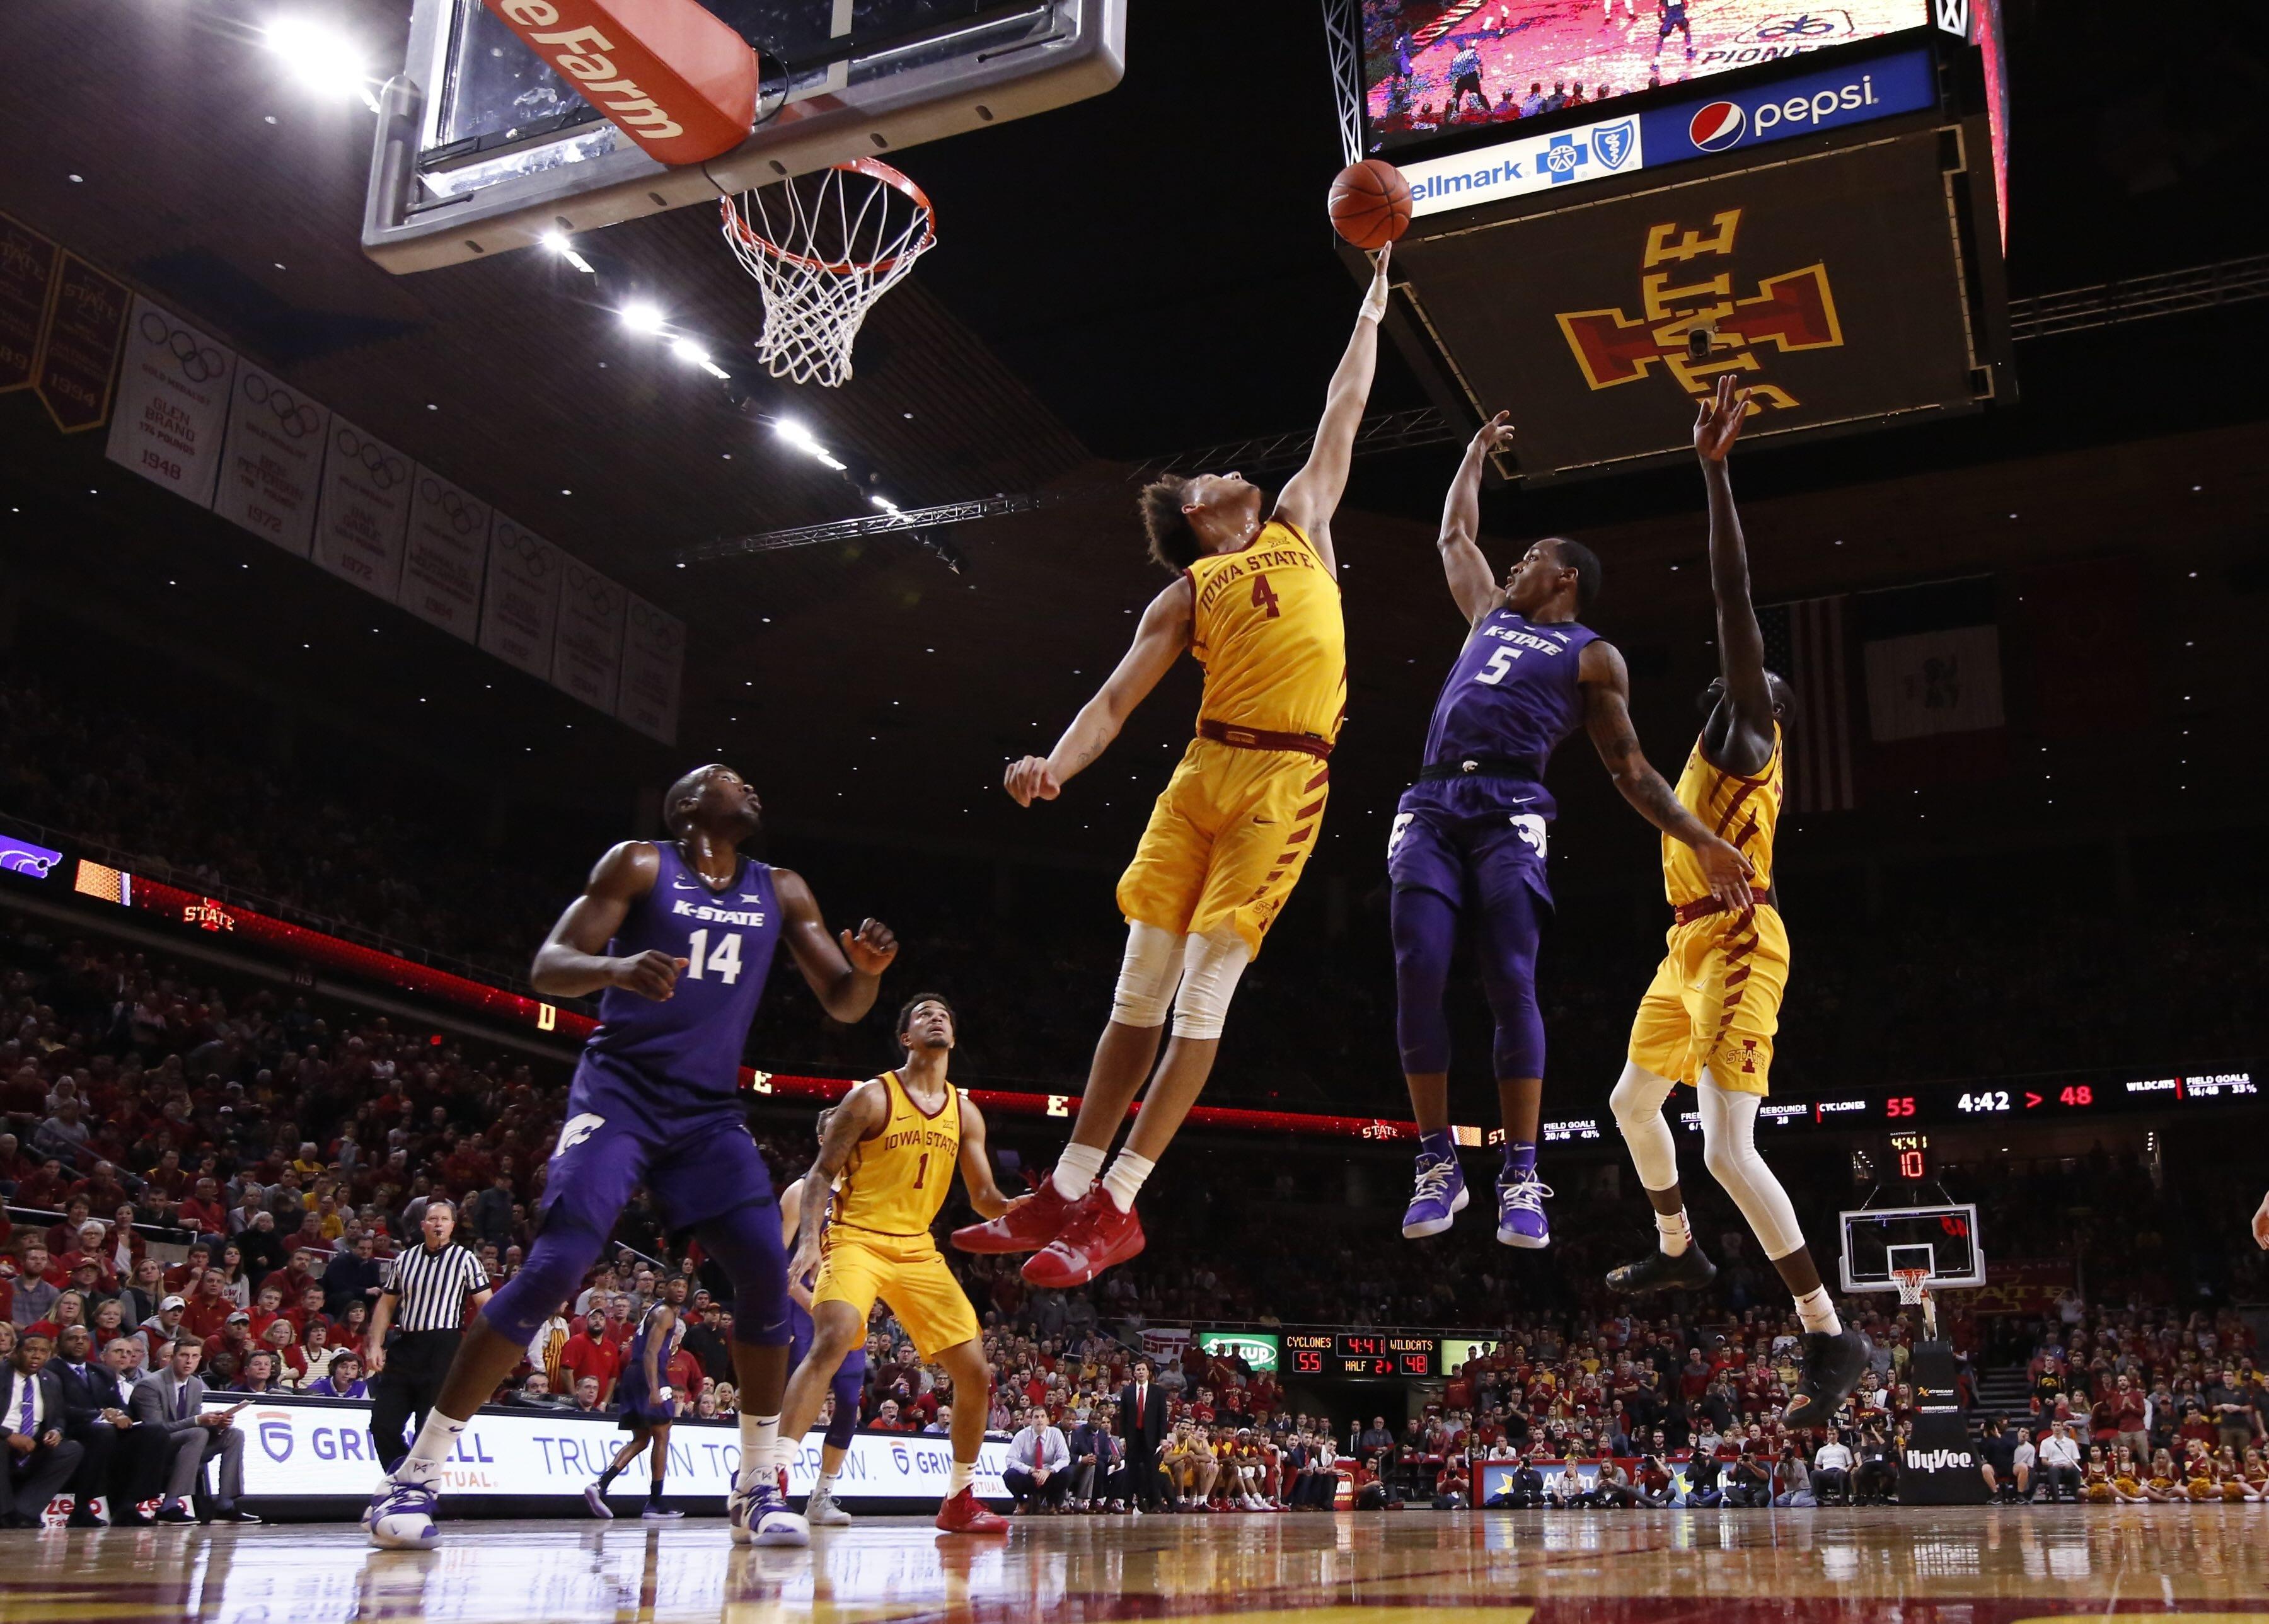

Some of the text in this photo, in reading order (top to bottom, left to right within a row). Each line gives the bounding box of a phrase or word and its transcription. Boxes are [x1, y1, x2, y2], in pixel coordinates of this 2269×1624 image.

[529, 25, 684, 139] Farm
[1754, 74, 1873, 137] pepsi
[1411, 160, 1523, 202] ellmark
[146, 406, 195, 442] BRAND
[154, 397, 190, 426] GLEN
[158, 431, 195, 456] POUNDS
[142, 449, 182, 480] 1948
[248, 504, 282, 533] 1972
[342, 554, 373, 580] 1972
[1199, 551, 1315, 613] IOWA STATE
[1251, 574, 1279, 618] 4
[1483, 625, 1564, 657] K-STATE
[1474, 645, 1524, 686] 5
[183, 906, 234, 931] STATE
[672, 900, 765, 928] K-STATE
[687, 928, 743, 985] 14
[2127, 1080, 2176, 1091] WILDCATS
[2186, 1073, 2249, 1085] FIELD GOALS
[1819, 1101, 1866, 1112] CYCLONES
[1886, 1097, 1916, 1117] 55
[1958, 1091, 2010, 1112] 4:42
[2060, 1085, 2093, 1107] 48
[1760, 1104, 1807, 1114] REBOUNDS
[1363, 1126, 1398, 1139] STATE
[1544, 1120, 1596, 1131] FIELD GOALS
[1689, 1122, 1704, 1131] 6/1
[884, 1131, 959, 1157] IOWA STATE
[1891, 1136, 1927, 1150] 4:41
[914, 1153, 928, 1189] 1
[1901, 1151, 1923, 1177] 10
[1287, 1336, 1332, 1348] CYCLONES
[1349, 1338, 1383, 1354] 4:41
[1390, 1339, 1433, 1350] WILDCATS
[1299, 1352, 1320, 1370] 55
[1345, 1360, 1383, 1373] HALF 2
[1406, 1356, 1426, 1373] 48
[312, 1427, 494, 1463] GRILL
[442, 1471, 492, 1487] TUAL
